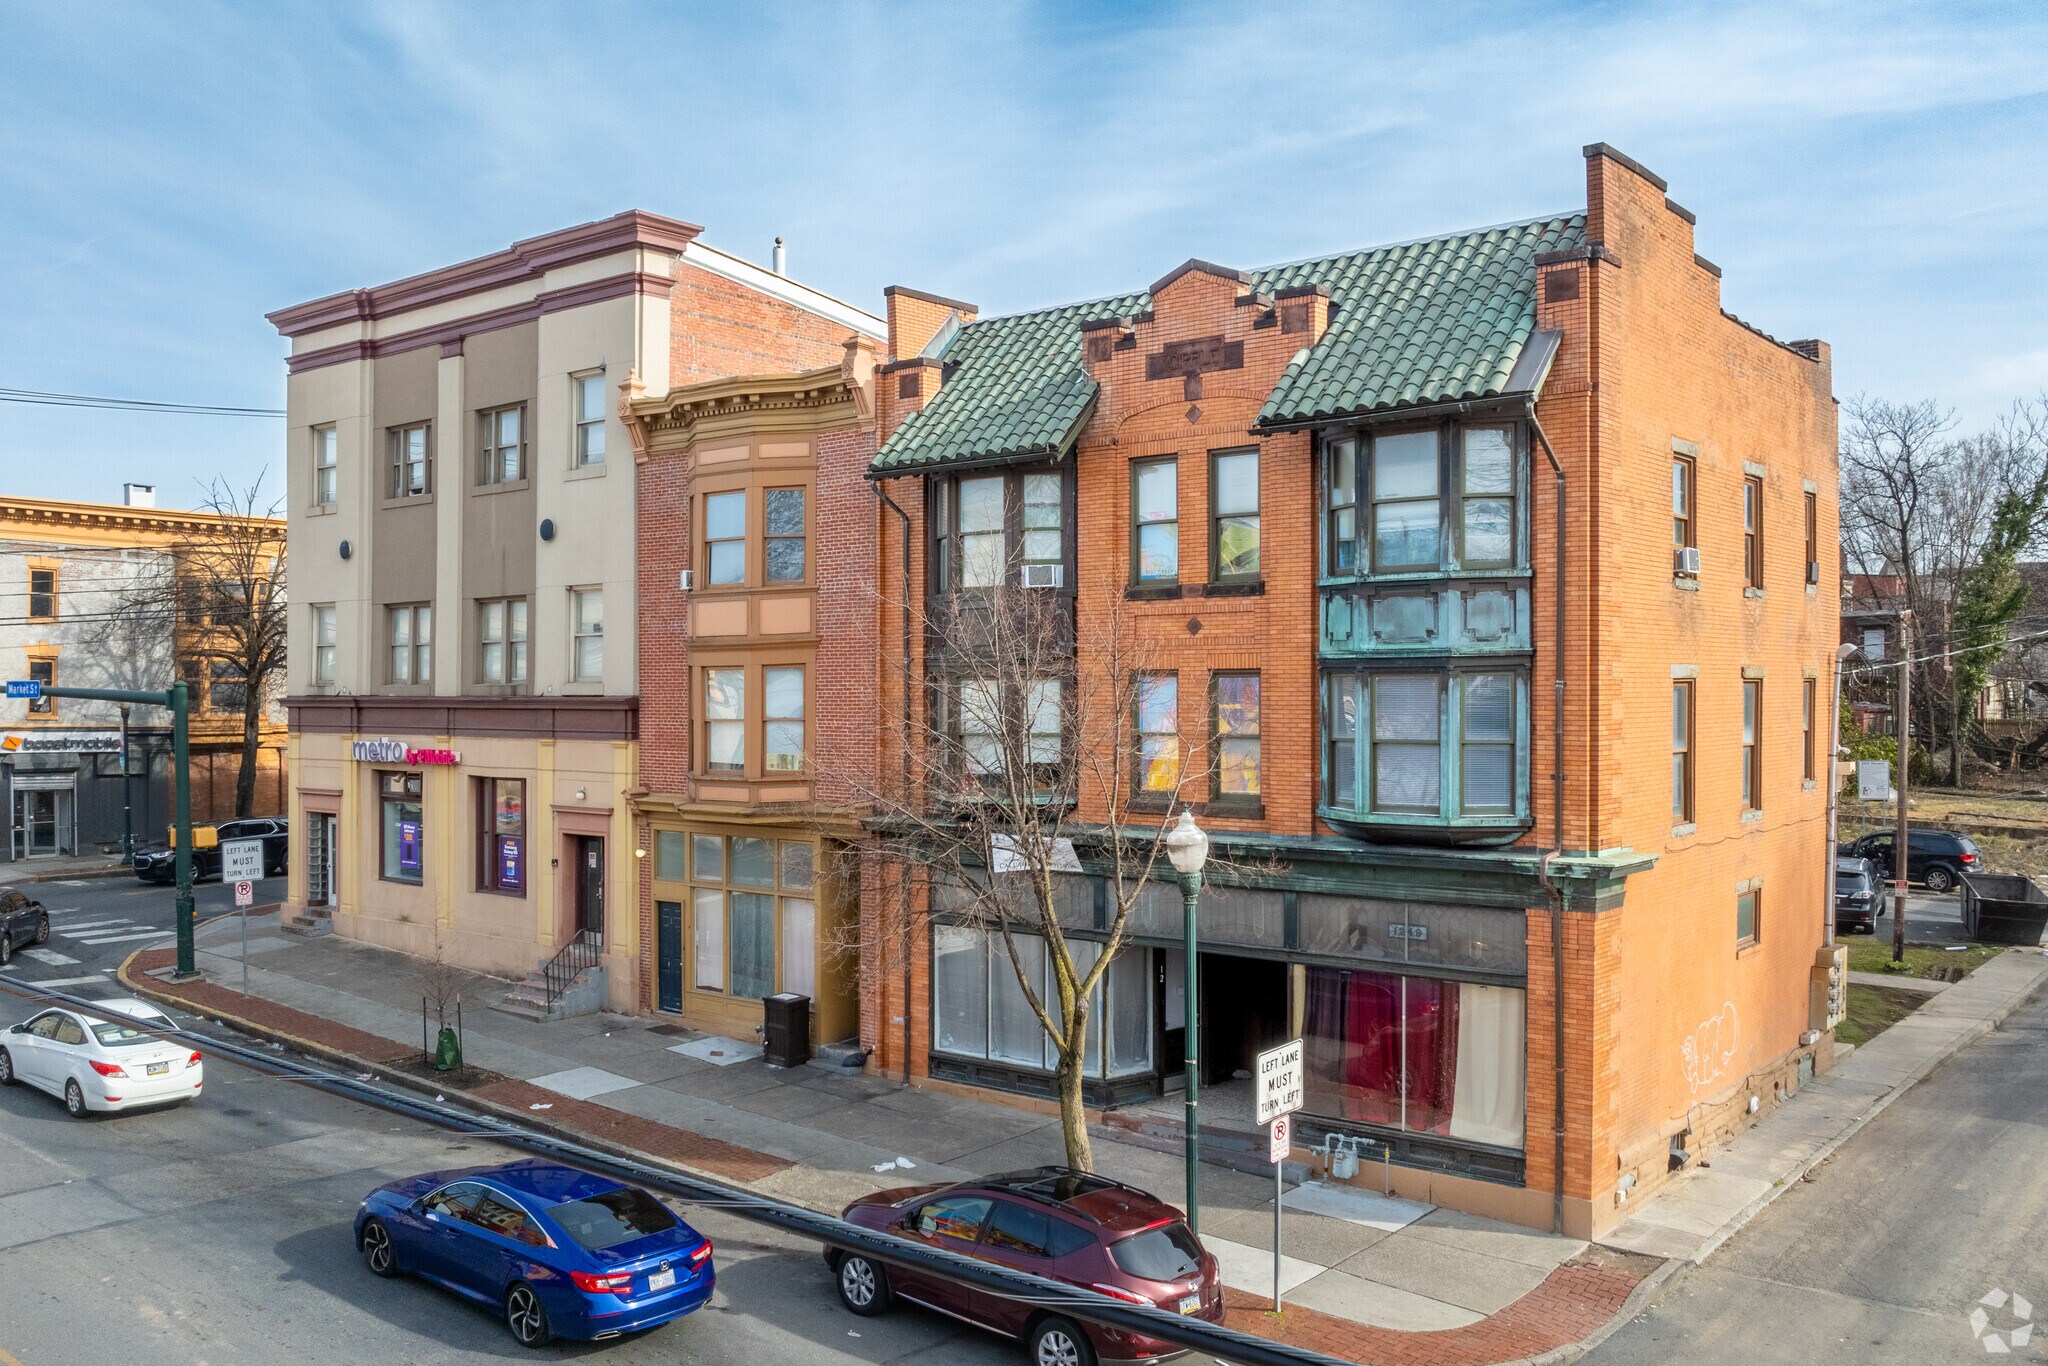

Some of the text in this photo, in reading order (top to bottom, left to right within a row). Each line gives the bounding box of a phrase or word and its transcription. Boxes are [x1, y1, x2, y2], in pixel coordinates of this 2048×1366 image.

[7, 683, 38, 694] Market St
[352, 737, 403, 763] metro
[405, 748, 418, 766] by
[226, 845, 260, 855] LEFT LANE
[232, 856, 254, 866] MUST
[245, 868, 260, 876] LEFT
[1261, 1050, 1299, 1074] LEFT LANE
[1268, 1071, 1293, 1092] MUST
[1261, 1089, 1300, 1114] TURN LEFT
